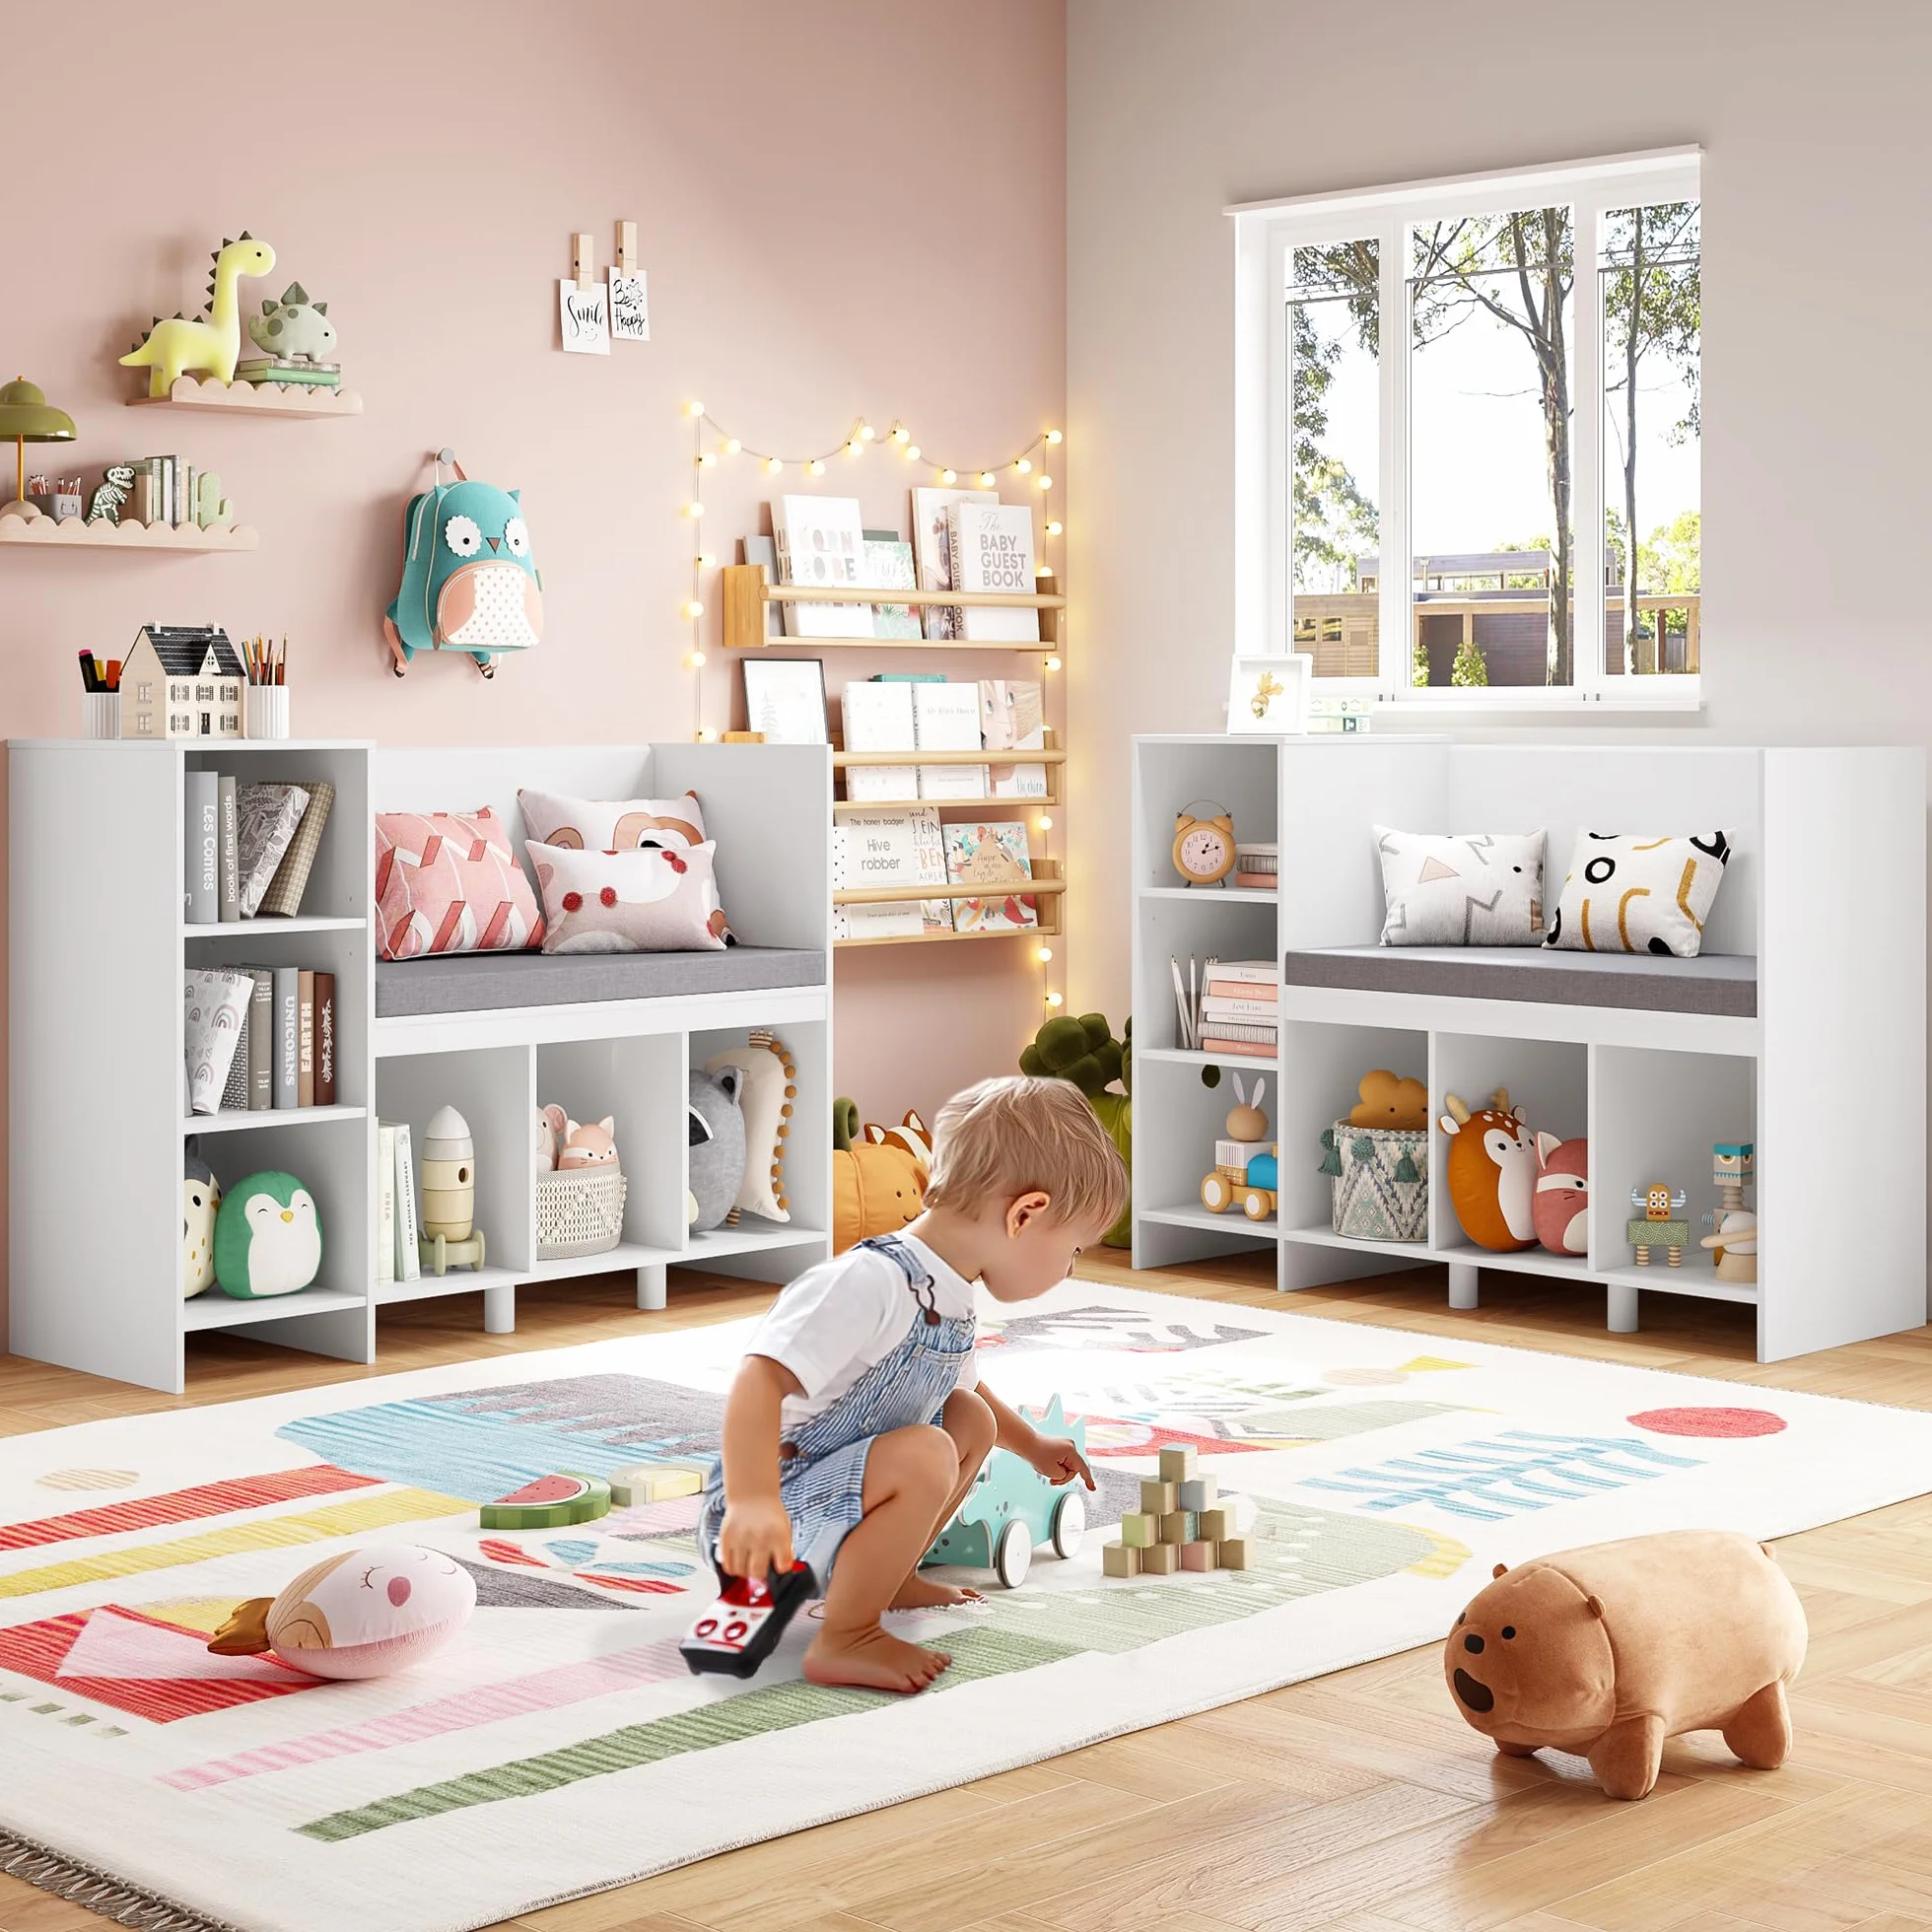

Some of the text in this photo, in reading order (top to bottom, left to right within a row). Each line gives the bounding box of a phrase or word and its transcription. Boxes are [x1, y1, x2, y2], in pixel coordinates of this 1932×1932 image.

[614, 308, 646, 336] Happy
[949, 530, 958, 559] BABY
[980, 533, 1017, 552] BABY
[981, 551, 1027, 571] GUEST
[952, 562, 961, 591] GUES
[982, 568, 1025, 588] BOOK
[225, 794, 234, 832] words
[863, 818, 881, 827] honey
[883, 817, 905, 826] badger
[203, 804, 216, 891] Les Contes
[226, 833, 235, 857] first
[867, 839, 890, 853] Hive
[228, 858, 236, 871] of
[861, 857, 901, 870] robber
[285, 996, 296, 1086] UNICORNS
[301, 1001, 311, 1073] EARTH
